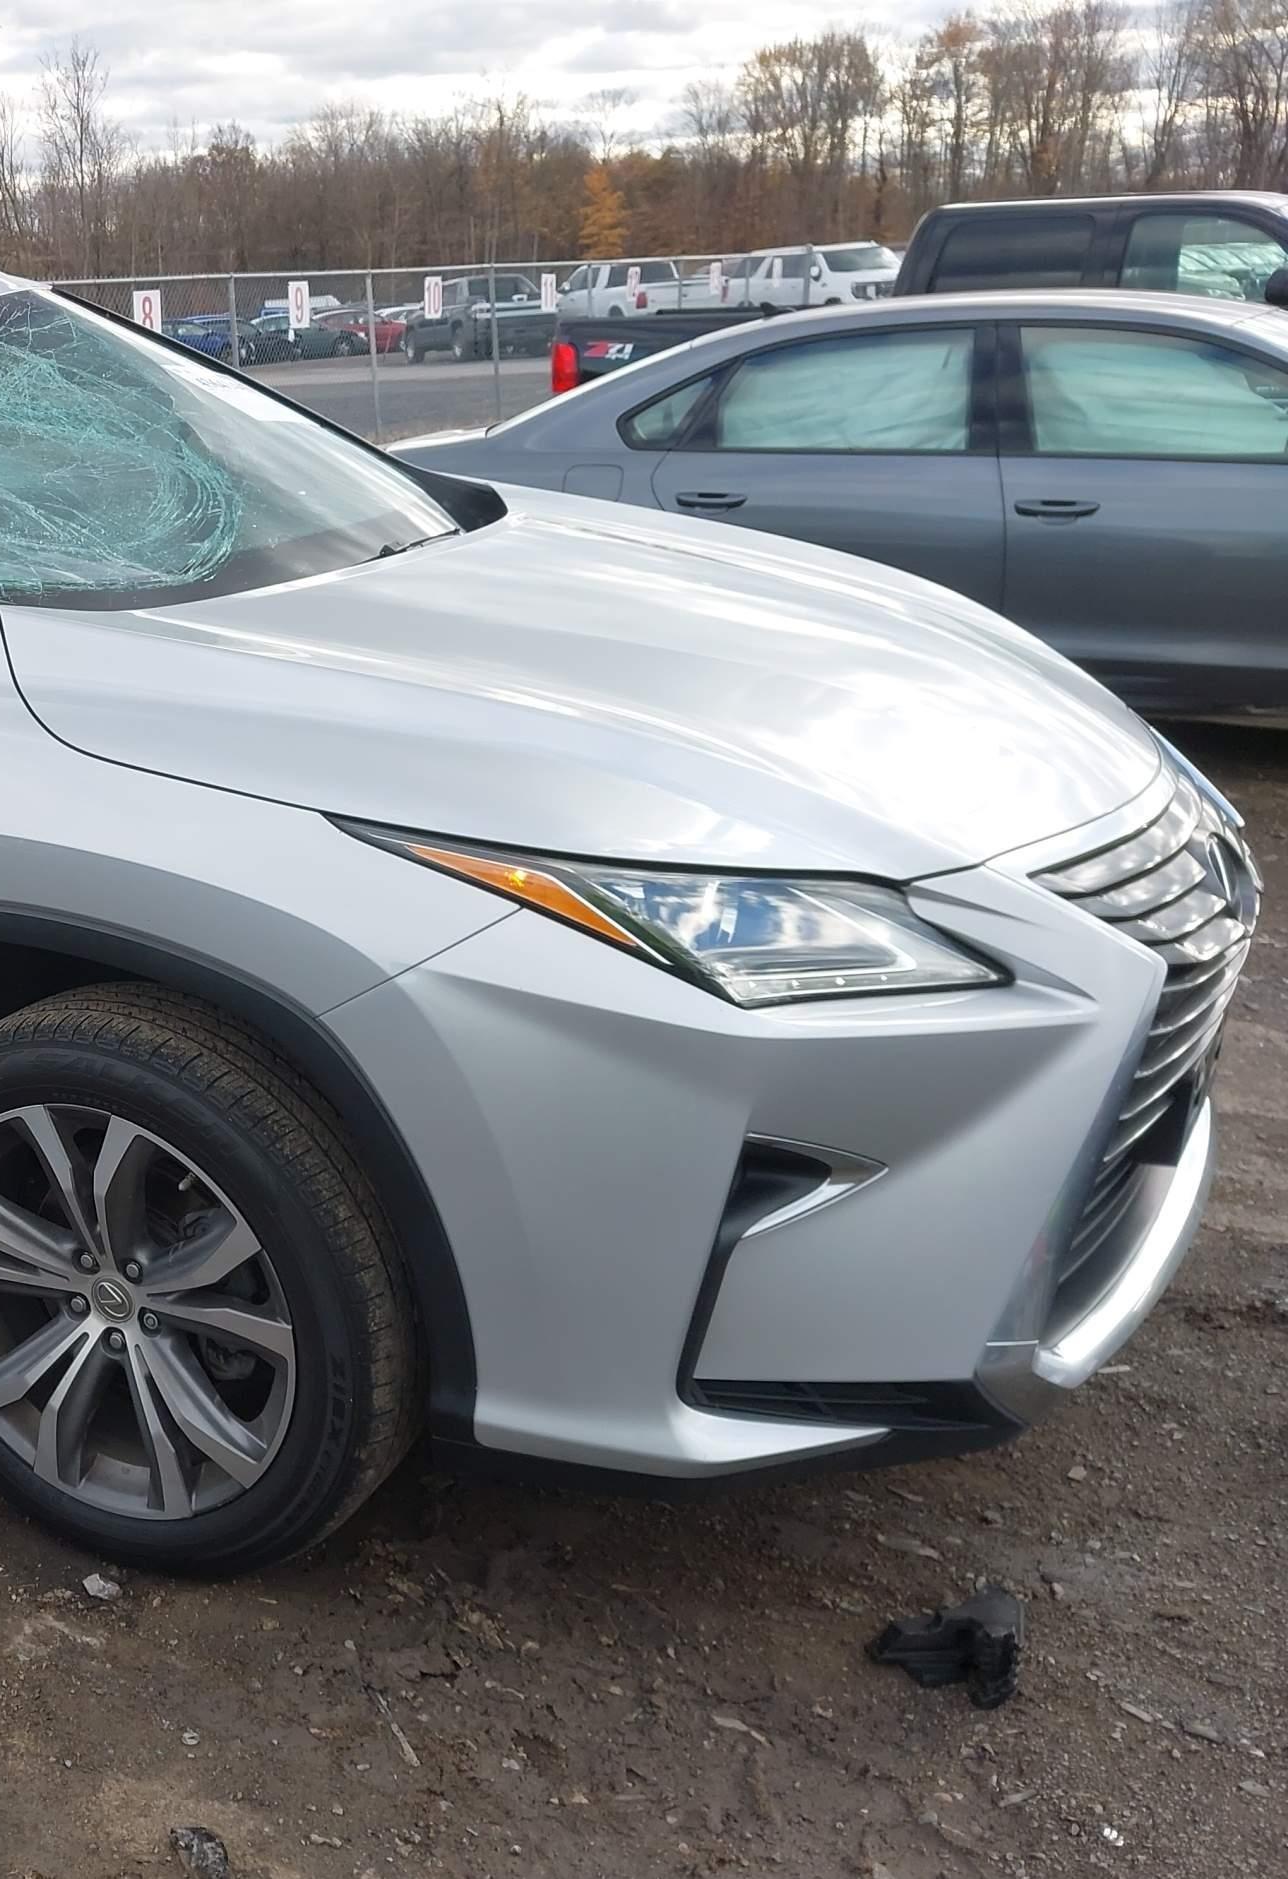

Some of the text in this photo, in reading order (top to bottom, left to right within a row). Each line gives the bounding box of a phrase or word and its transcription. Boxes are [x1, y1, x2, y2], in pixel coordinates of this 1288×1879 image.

[141, 296, 154, 330] 8
[295, 286, 304, 324] 9
[426, 281, 440, 315] 10
